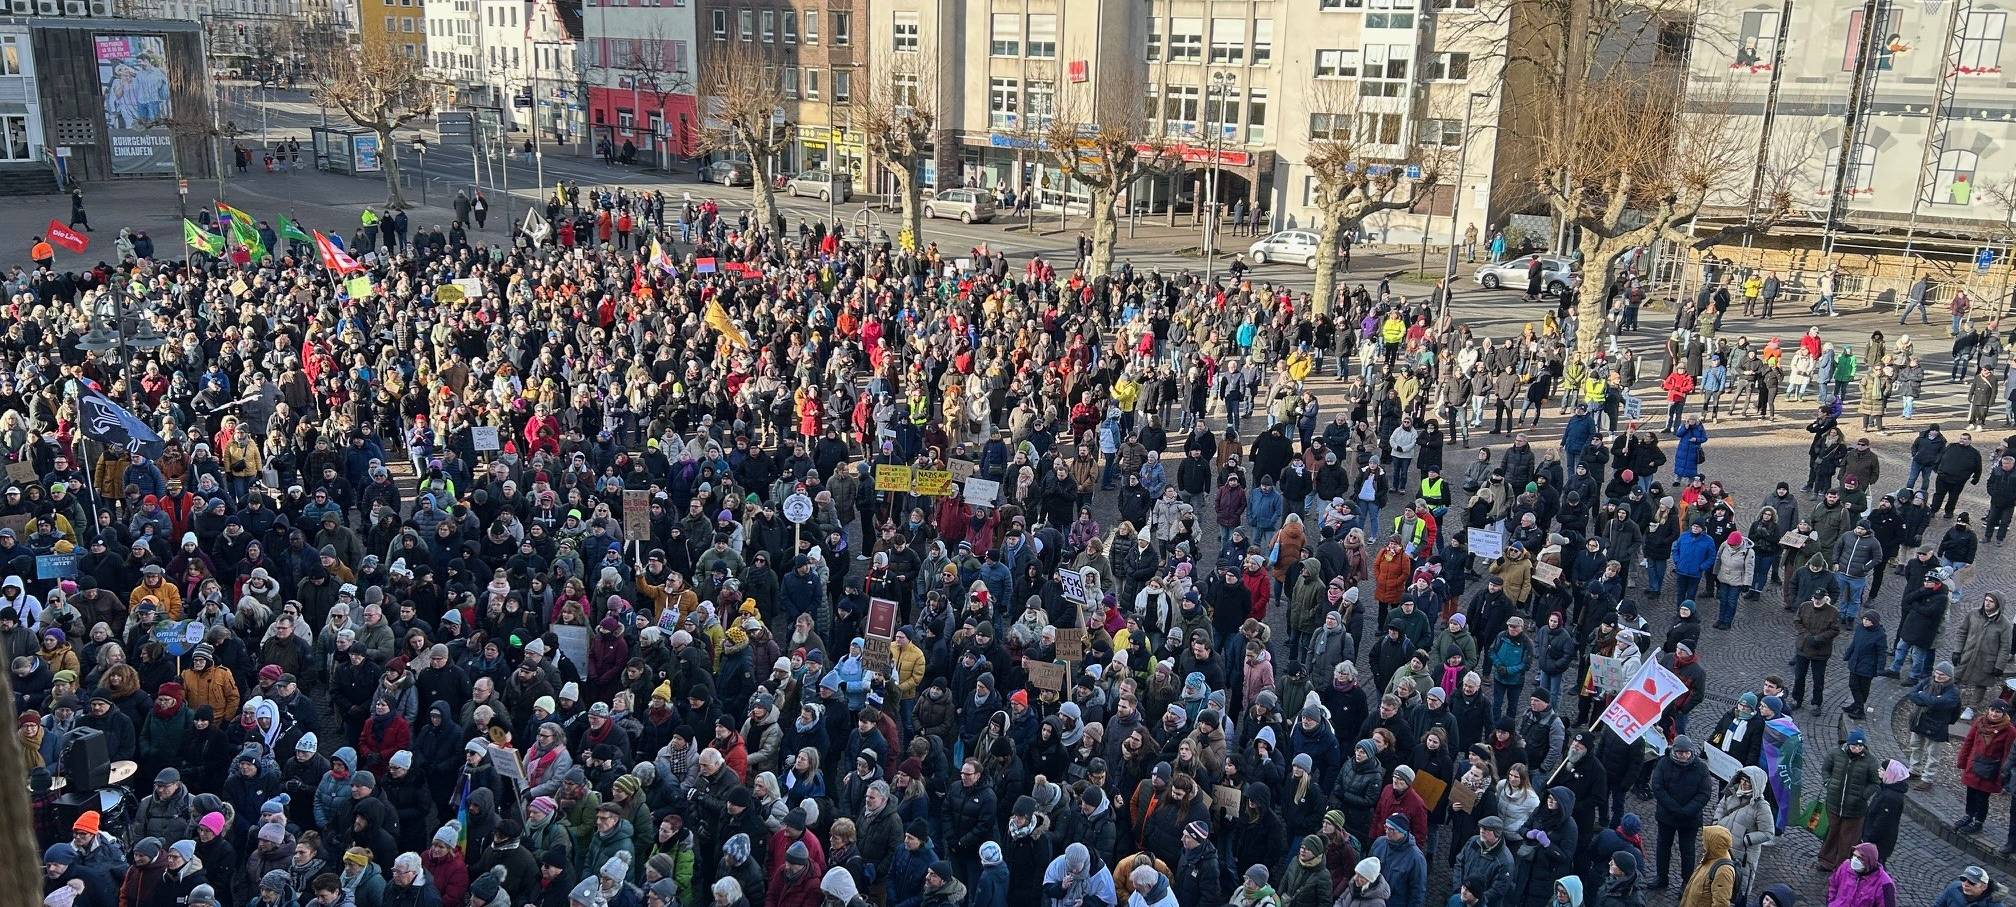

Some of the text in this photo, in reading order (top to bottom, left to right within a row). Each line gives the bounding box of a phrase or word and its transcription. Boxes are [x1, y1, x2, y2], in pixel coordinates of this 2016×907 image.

[114, 146, 154, 157] EINKAUFEN
[918, 471, 938, 479] NAZIS
[1061, 575, 1083, 589] FCK
[1062, 584, 1084, 598] AfD
